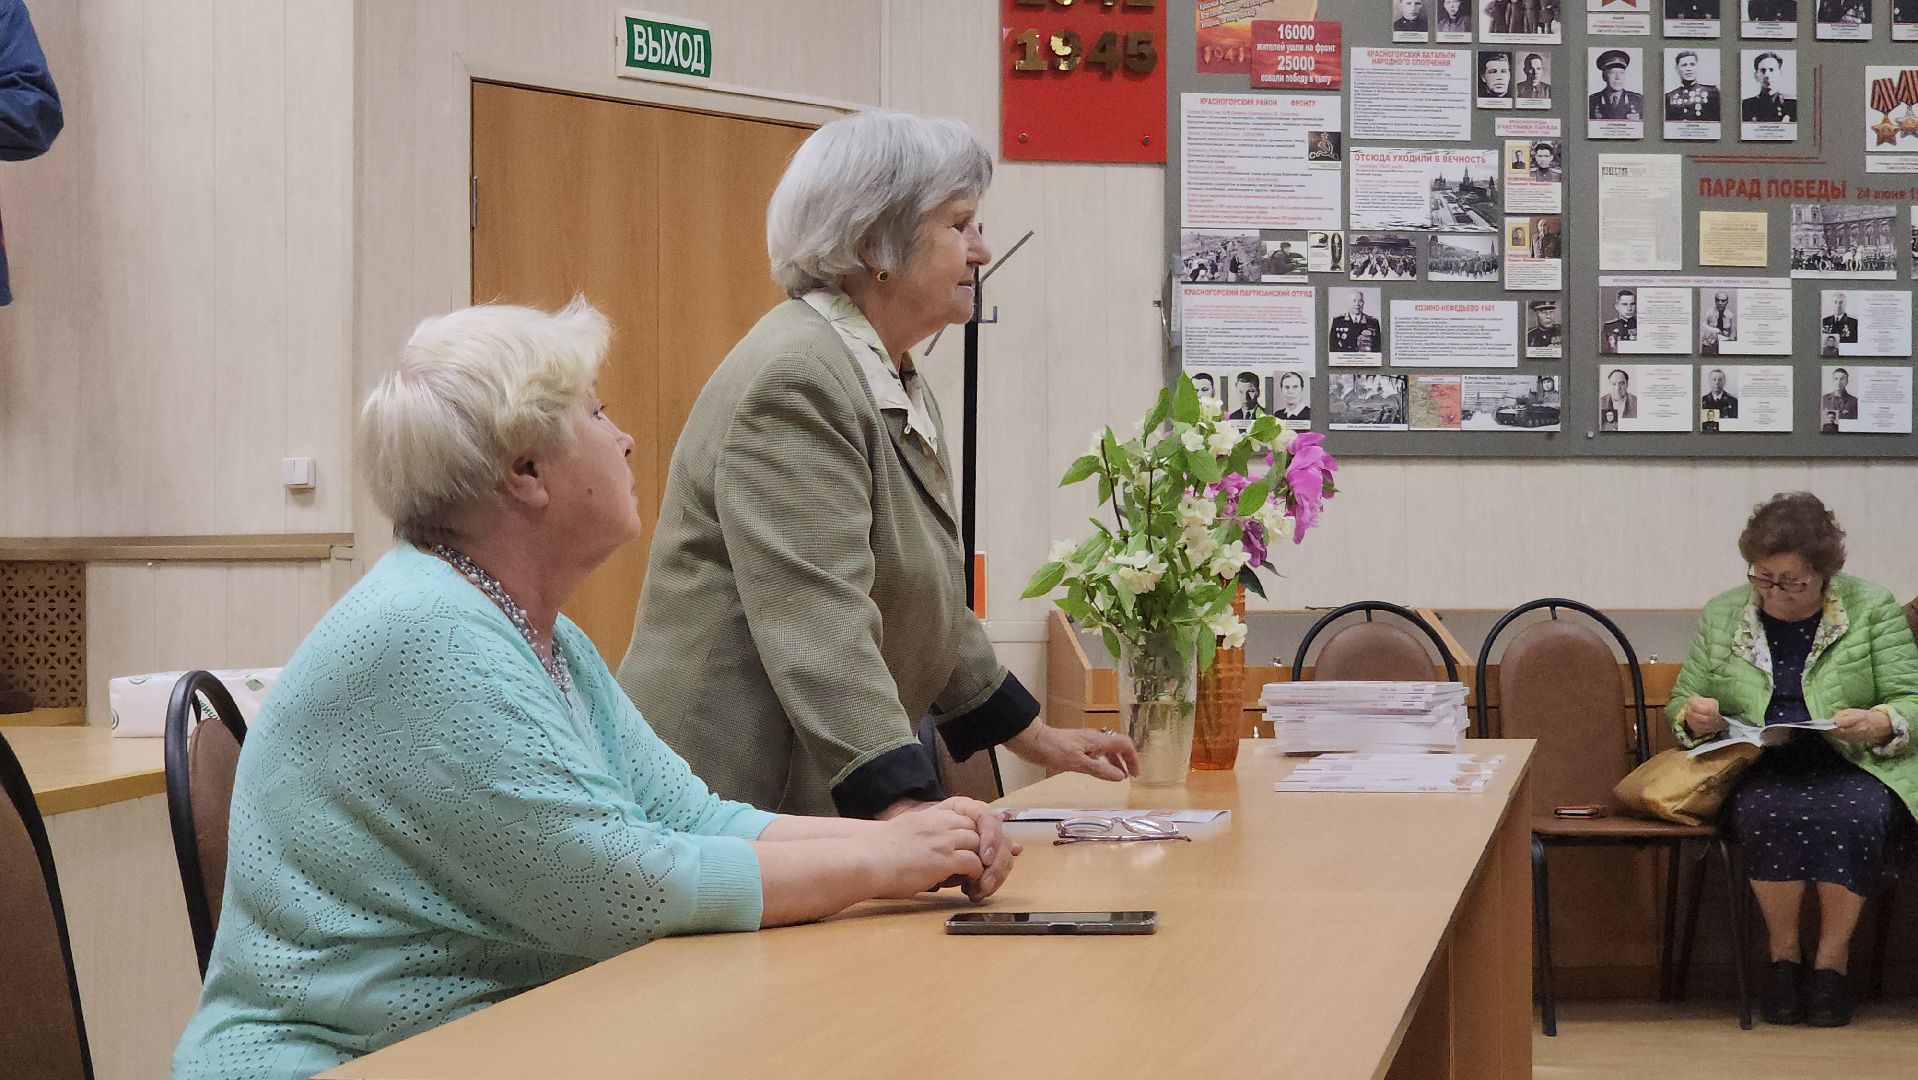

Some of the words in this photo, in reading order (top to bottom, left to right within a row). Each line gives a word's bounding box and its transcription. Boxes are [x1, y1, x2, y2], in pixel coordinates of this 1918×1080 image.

[1277, 24, 1315, 40] 16000
[633, 24, 705, 74] ВЫХОД
[1015, 28, 1157, 73] 1945
[1256, 42, 1286, 51] жителей
[1286, 44, 1304, 53] ушли
[1314, 43, 1336, 54] фронт
[1203, 46, 1246, 64] 1941
[1366, 50, 1422, 58] КРАСНОГОРСКИЙ
[1424, 51, 1456, 59] БАТАЛЬОН
[1277, 55, 1315, 71] 25000
[1371, 58, 1410, 66] НАРОДНОГО
[1260, 74, 1284, 82] ковали
[1285, 72, 1307, 85] победу
[1200, 98, 1254, 106] КРАСНОГОРСКИЙ
[1354, 153, 1391, 163] ОТСЮДА
[1391, 154, 1432, 164] УХОДИЛИ
[1435, 155, 1440, 163] В
[1442, 155, 1486, 164] ВЕЧНОСТЬ
[1699, 178, 1761, 201] ПАРАД
[1767, 178, 1847, 202] ПОБЕДЫ
[1856, 187, 1871, 199] 24
[1873, 190, 1905, 200] июня
[1184, 288, 1239, 296] КРАСНОГОРСКИЙ
[1240, 289, 1290, 297] ПАРТИЗАНСКИЙ
[1292, 290, 1313, 298] ОТРЯД
[1414, 304, 1479, 312] КОЗИНО-НЕФЕДЬЕВО
[1481, 304, 1495, 312] 1941
